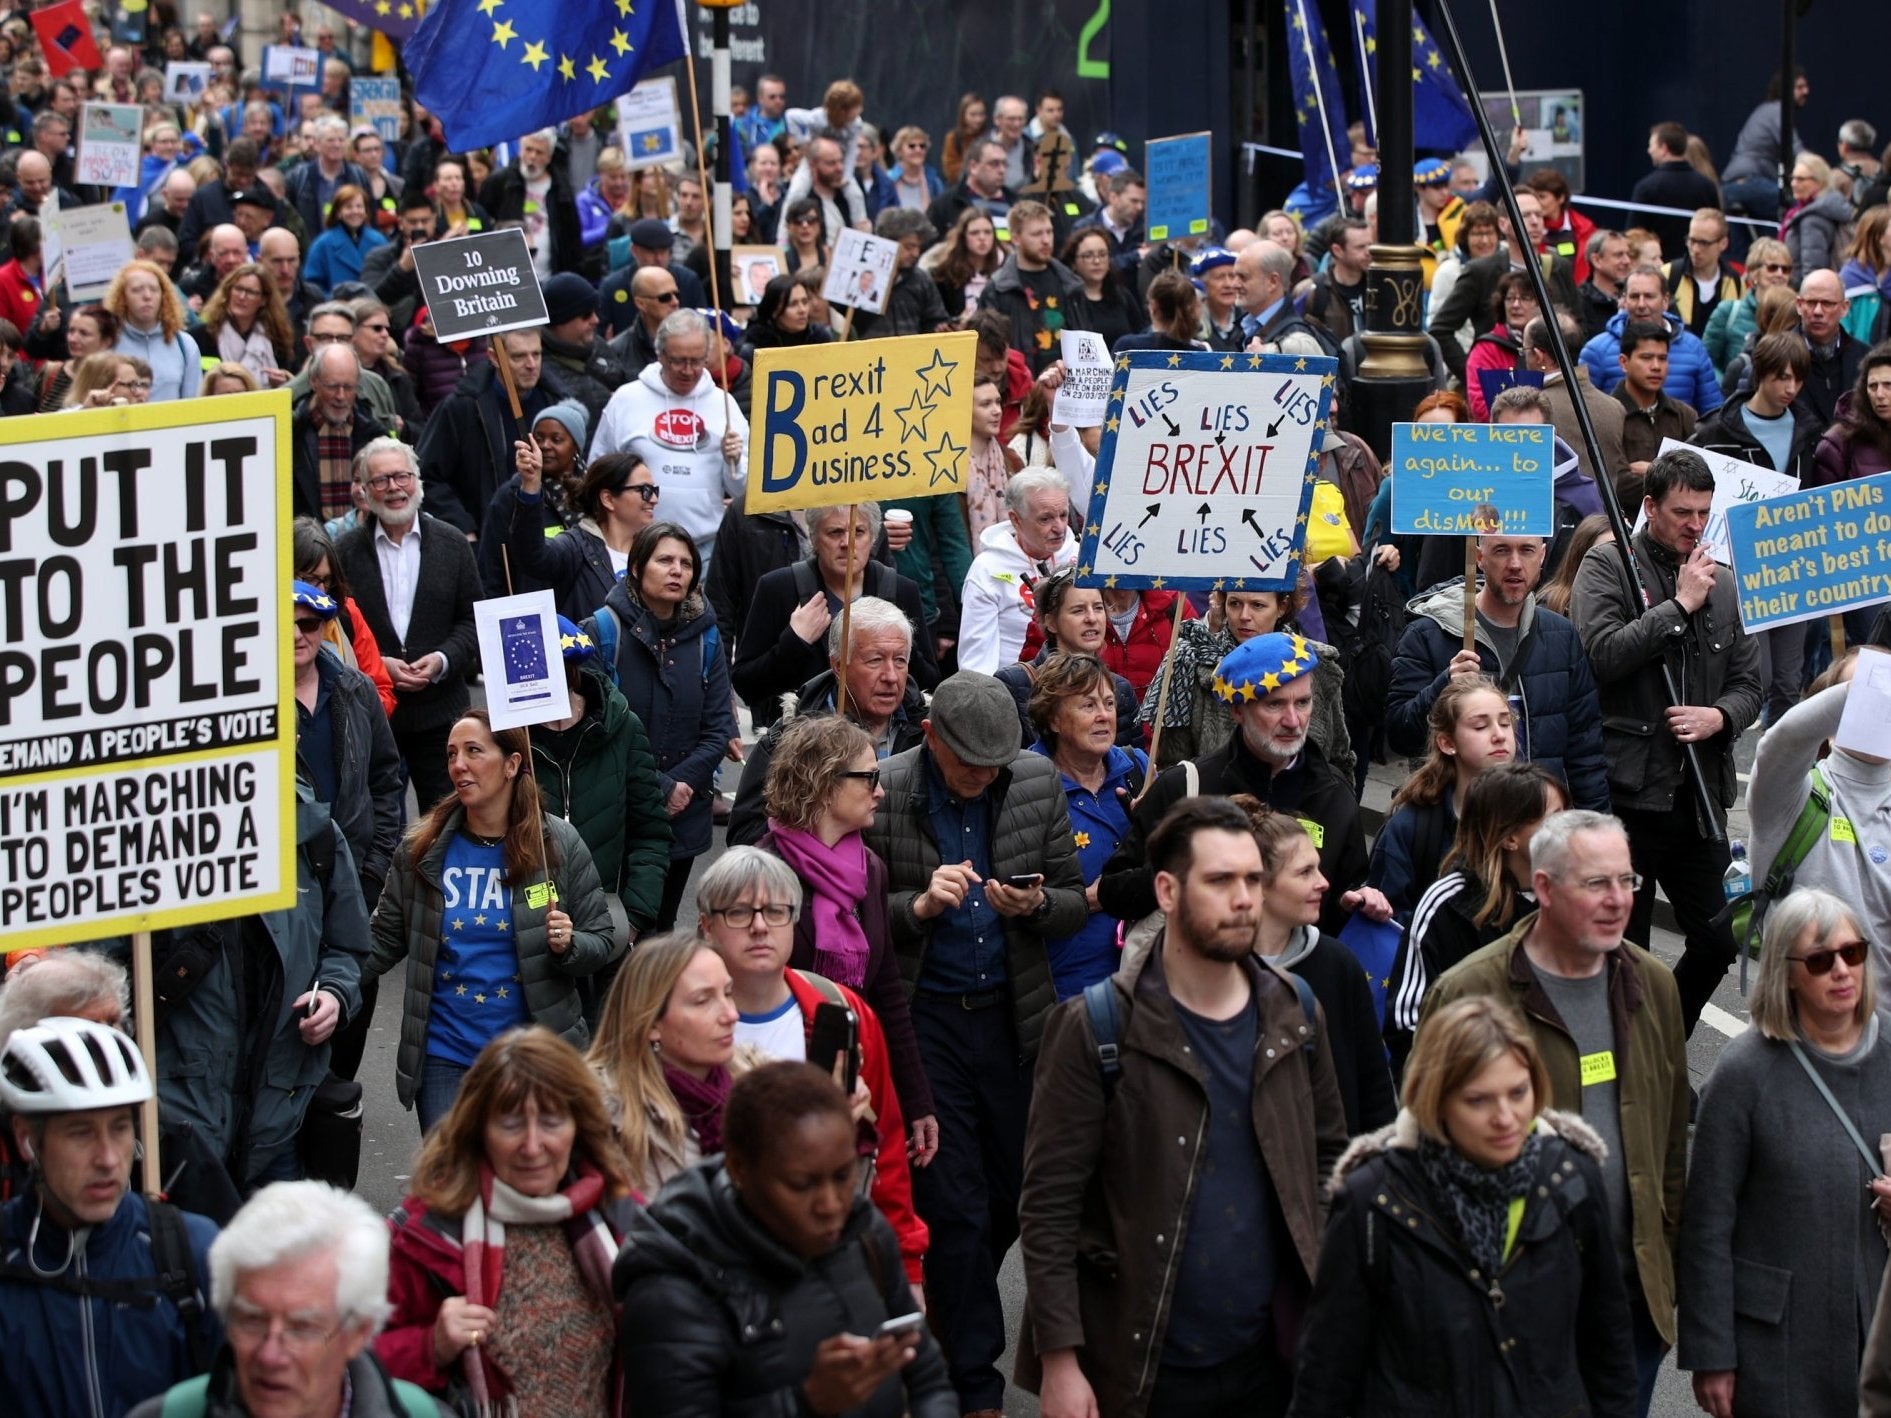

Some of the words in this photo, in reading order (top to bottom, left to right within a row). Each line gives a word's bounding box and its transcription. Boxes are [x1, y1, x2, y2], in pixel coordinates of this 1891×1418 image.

[434, 266, 520, 294] Downing
[463, 251, 482, 268] 10
[453, 291, 518, 317] Britain
[863, 402, 884, 438] 4
[1128, 382, 1179, 429] LIES
[1200, 405, 1249, 432] LIES
[1273, 379, 1317, 426] LIES
[1411, 424, 1477, 443] We're
[1489, 425, 1543, 443] here
[1142, 443, 1275, 495] BREXIT
[1405, 454, 1500, 478] again...
[1512, 452, 1539, 472] to
[0, 448, 152, 552] PUT
[186, 436, 257, 532] IT
[1448, 488, 1495, 501] our
[1733, 479, 1766, 501] Sta
[1755, 495, 1825, 529] Aren't
[1831, 484, 1883, 512] PMs
[1103, 522, 1145, 565] LIES
[1177, 527, 1227, 554] LIES
[1250, 528, 1293, 572] LIES
[1754, 525, 1827, 558] meant
[1834, 521, 1858, 541] to
[1864, 512, 1891, 535] do
[0, 555, 83, 643] TO
[113, 532, 258, 628] THE
[1743, 557, 1817, 590] what's
[1822, 543, 1870, 574] best
[1743, 590, 1798, 621] their
[0, 621, 260, 725] PEOPLE
[0, 736, 73, 771] EMAND
[80, 733, 95, 761] A
[101, 718, 213, 758] PEOPLE'S
[218, 708, 276, 741] VOTE
[0, 789, 48, 836] I'M
[64, 761, 256, 827] MARCHING
[0, 836, 48, 882] TO
[66, 811, 221, 874] DEMAND
[236, 806, 259, 849] A
[2, 869, 161, 926] PEOPLES
[175, 853, 259, 900] VOTE
